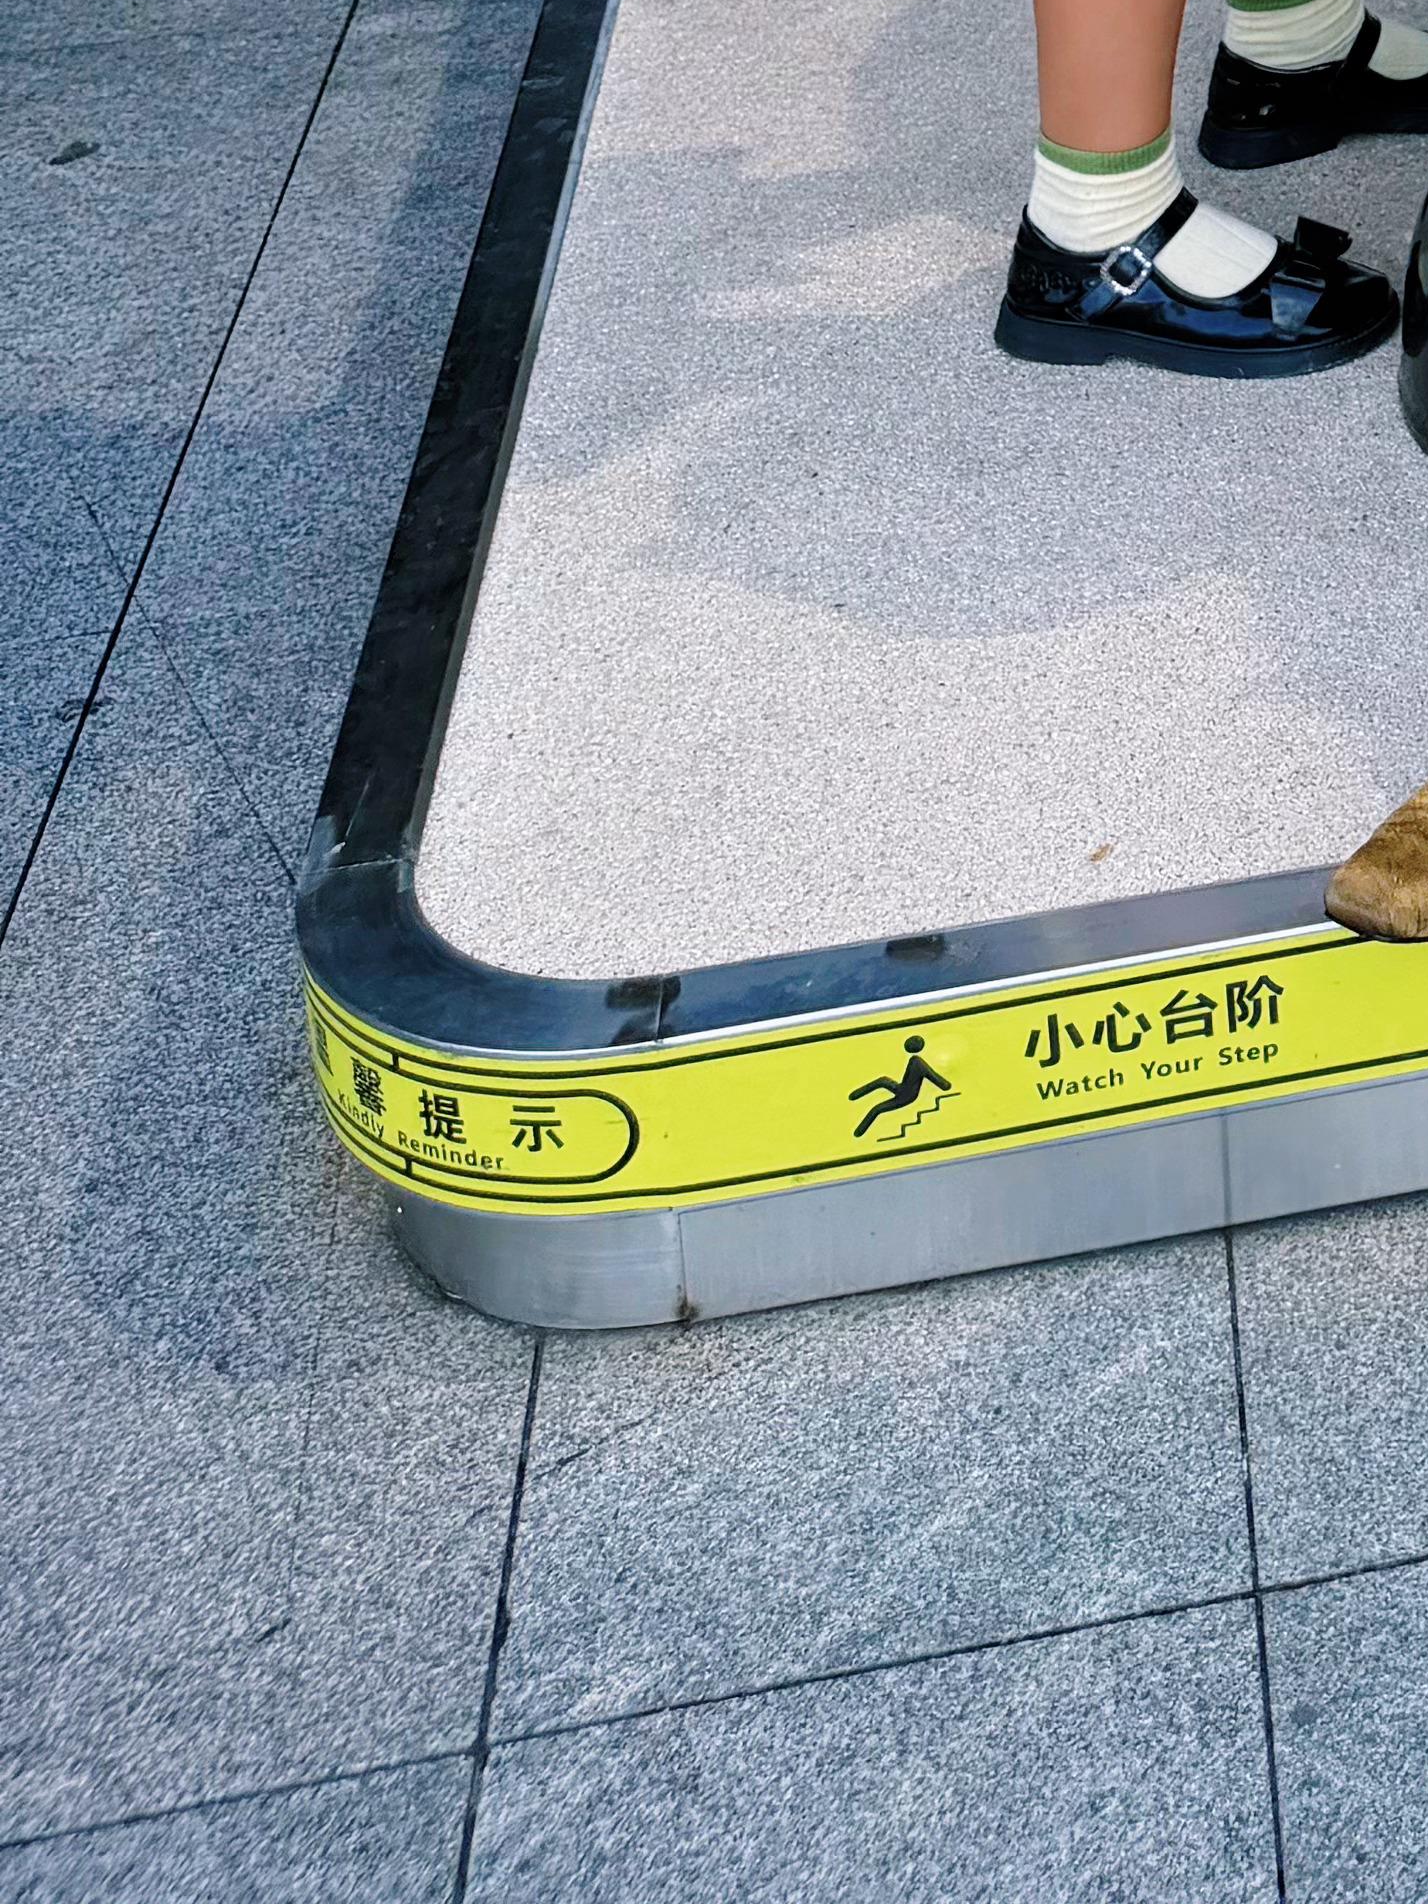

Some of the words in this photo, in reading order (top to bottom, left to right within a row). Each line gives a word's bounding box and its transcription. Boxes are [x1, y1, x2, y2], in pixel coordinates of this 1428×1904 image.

[1024, 975, 1284, 1068] 小心台阶
[1036, 1068, 1125, 1100] Watch
[1140, 1055, 1204, 1080] Your
[1218, 1042, 1279, 1067] Step
[337, 1087, 385, 1139] Kindly
[397, 1130, 504, 1170] Reminder
